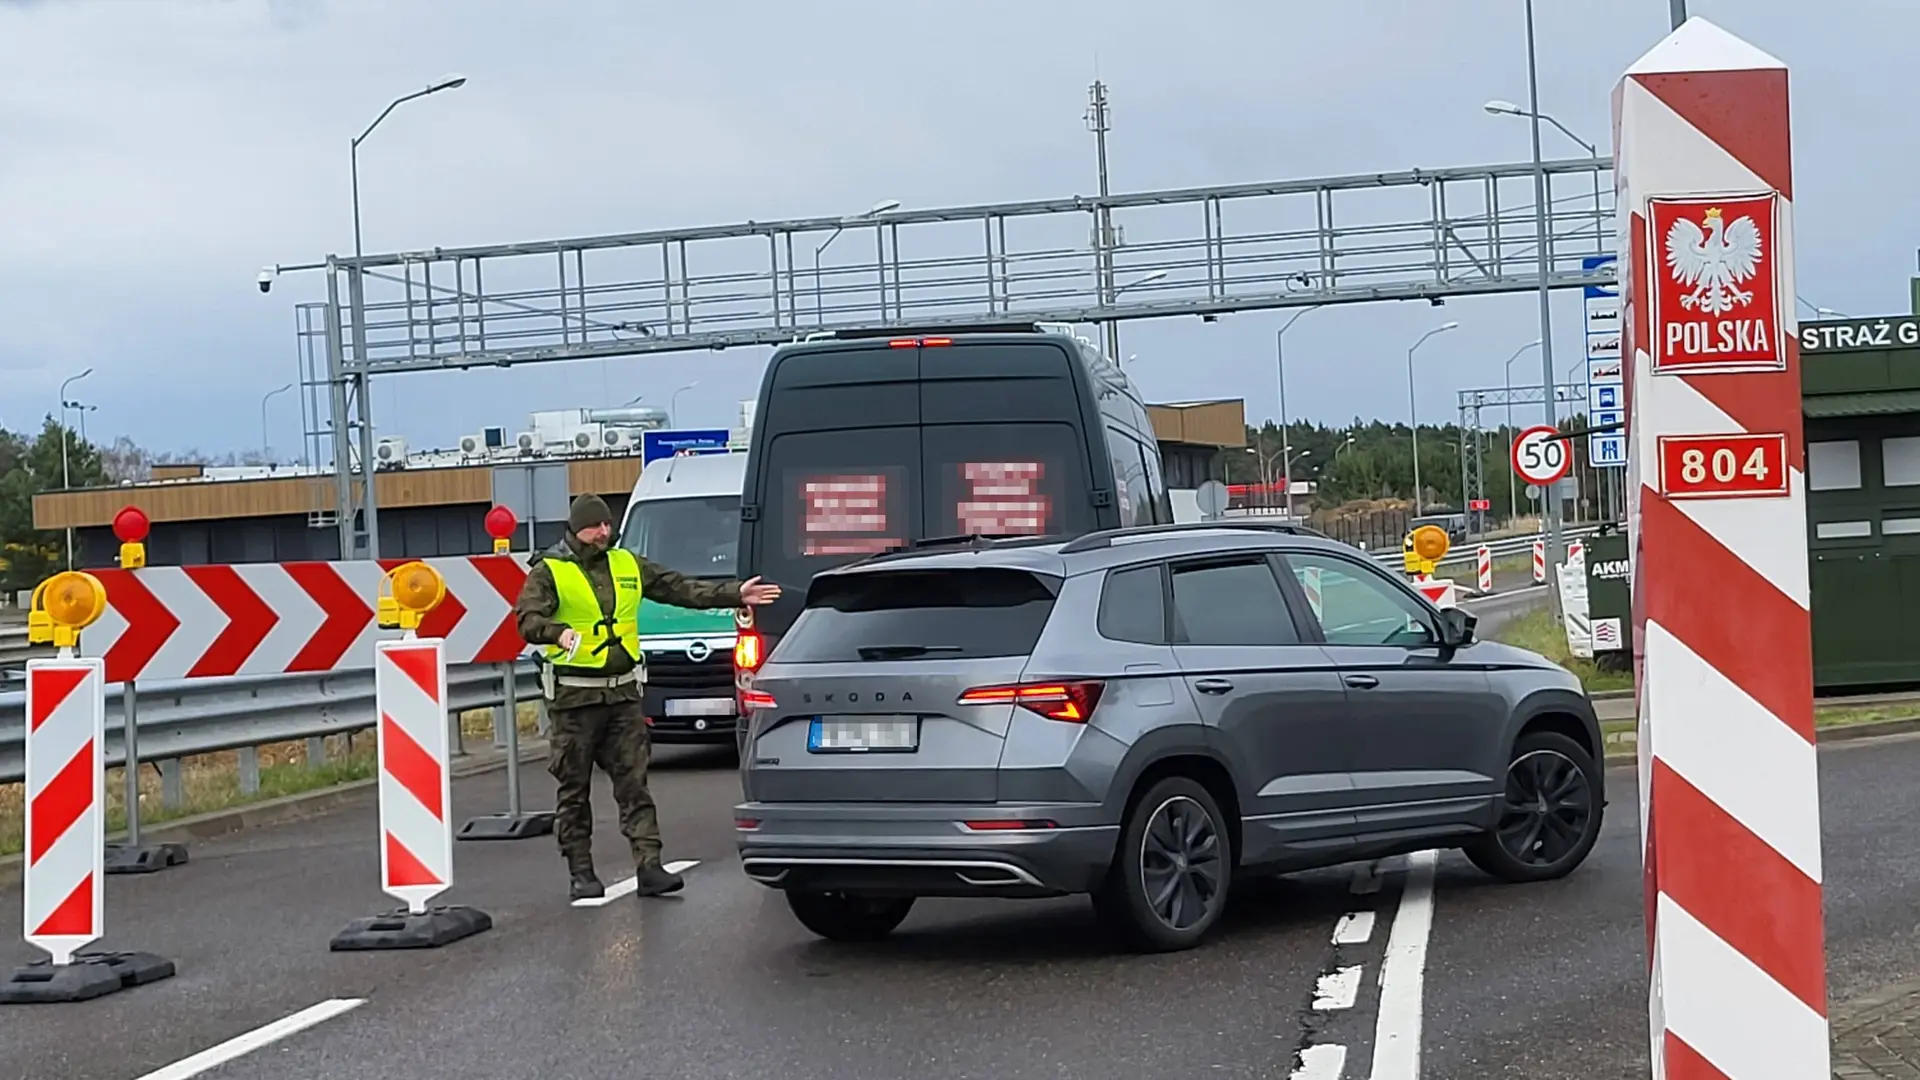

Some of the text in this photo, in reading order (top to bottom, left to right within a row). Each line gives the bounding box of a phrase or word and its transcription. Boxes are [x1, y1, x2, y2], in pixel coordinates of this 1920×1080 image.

[1666, 319, 1769, 356] POLSKA
[1802, 319, 1892, 349] STRAŻ
[1524, 442, 1562, 469] 50
[1681, 447, 1769, 483] 804
[1591, 560, 1629, 576] AKM
